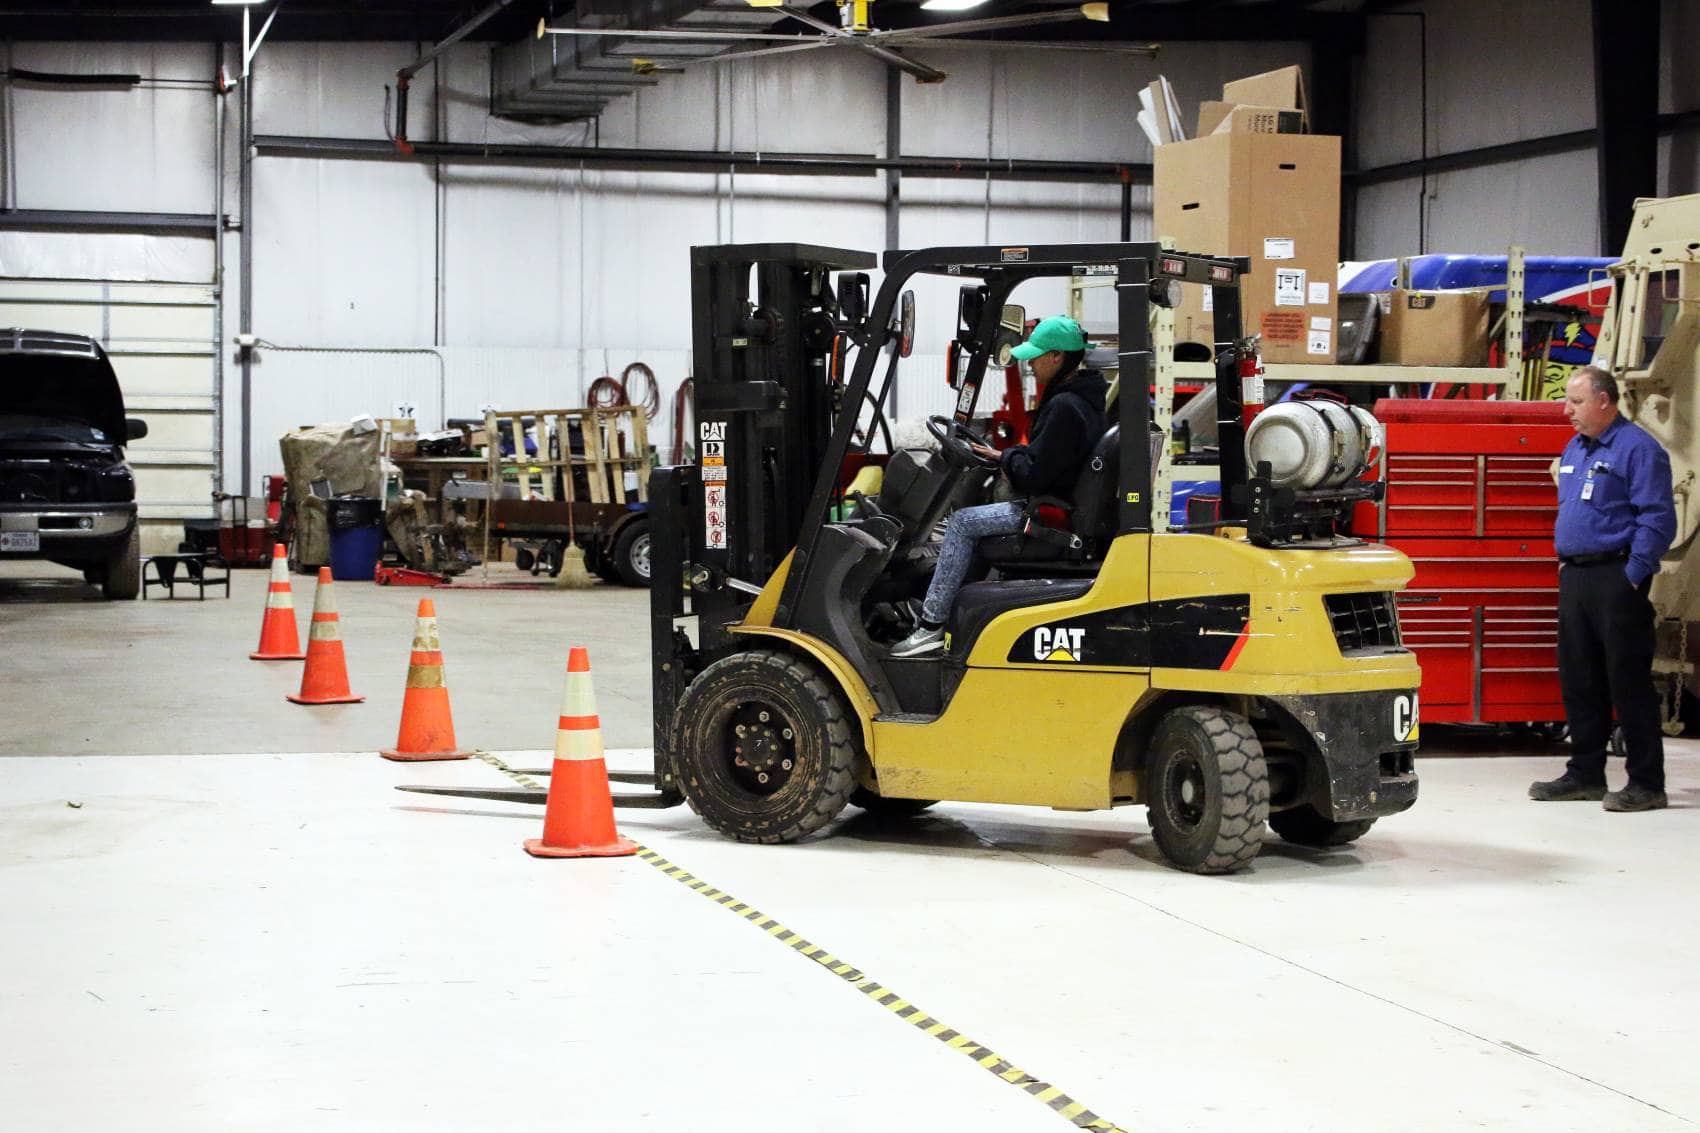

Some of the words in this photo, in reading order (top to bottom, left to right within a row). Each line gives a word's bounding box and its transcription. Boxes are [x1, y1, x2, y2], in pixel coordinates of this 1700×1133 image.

[701, 422, 727, 440] CAT
[1034, 627, 1085, 661] CAT
[1394, 694, 1419, 742] CA
